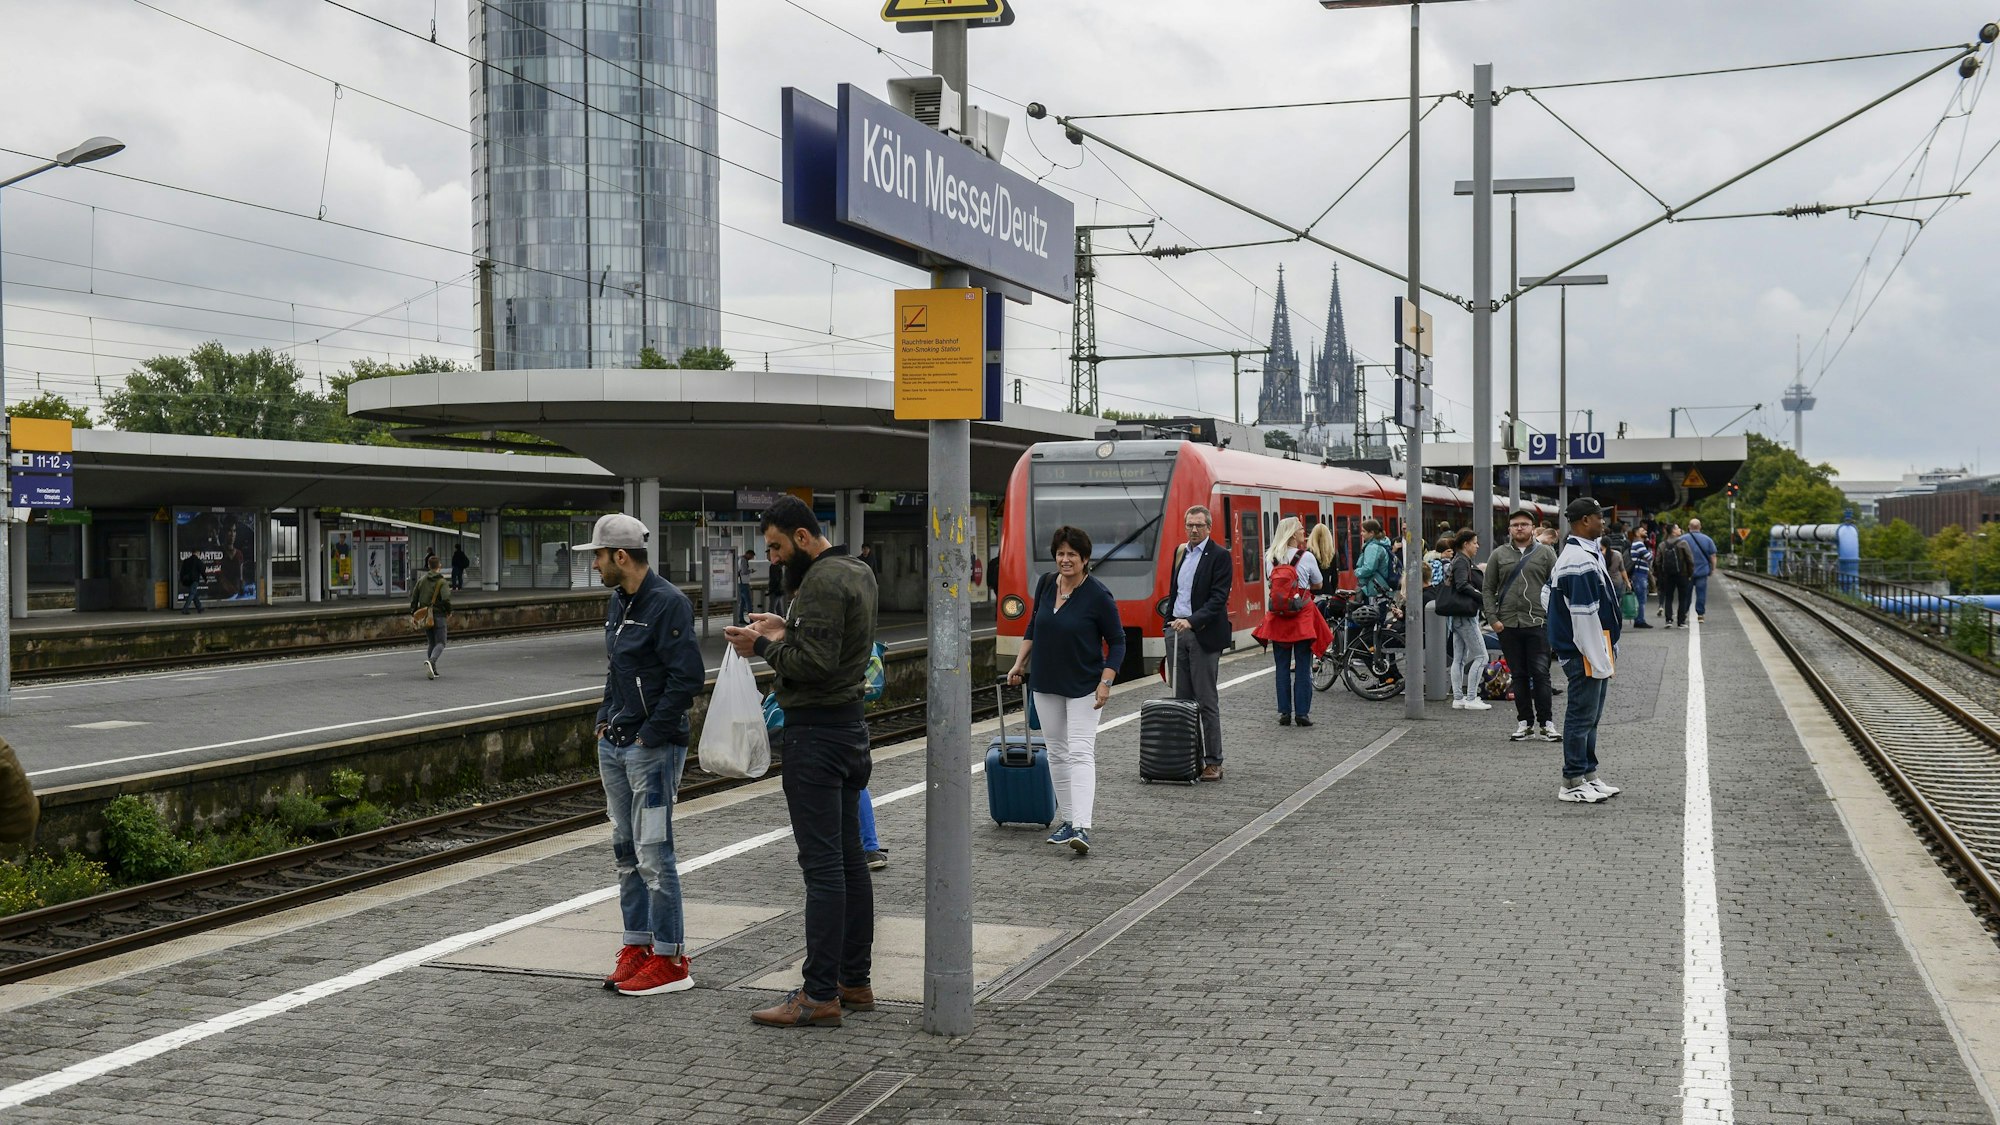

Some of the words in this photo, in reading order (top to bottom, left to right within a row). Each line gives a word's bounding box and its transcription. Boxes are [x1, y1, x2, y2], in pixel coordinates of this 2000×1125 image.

[863, 118, 917, 204] Köln
[925, 148, 1048, 259] Messe/Deutz
[902, 346, 940, 354] Non-Smoking
[1532, 434, 1547, 455] 9
[1575, 433, 1601, 454] 10
[36, 455, 60, 468] 11-12
[180, 551, 223, 560] UNARTED
